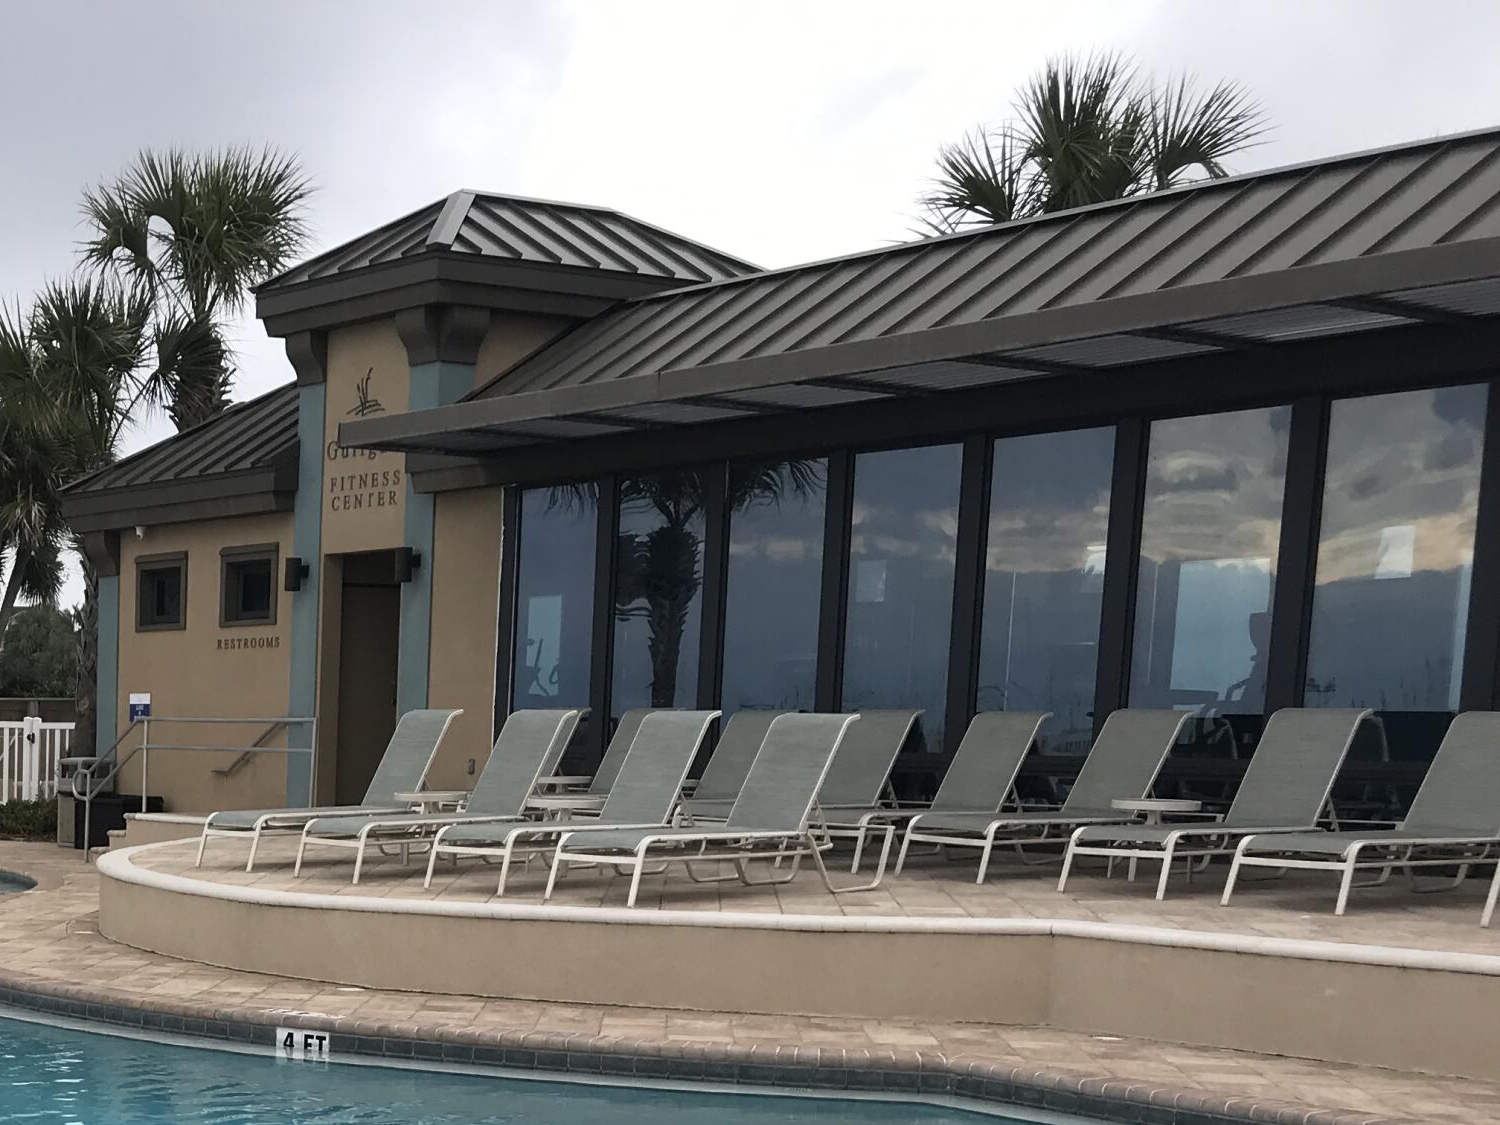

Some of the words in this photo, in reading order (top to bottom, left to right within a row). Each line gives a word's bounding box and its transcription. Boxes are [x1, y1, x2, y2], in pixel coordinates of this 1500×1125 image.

[329, 469, 401, 494] FITNESS
[331, 490, 398, 512] CENTER
[216, 636, 280, 651] RESTROOMS
[283, 1032, 295, 1048] 4
[304, 1033, 327, 1051] FT
